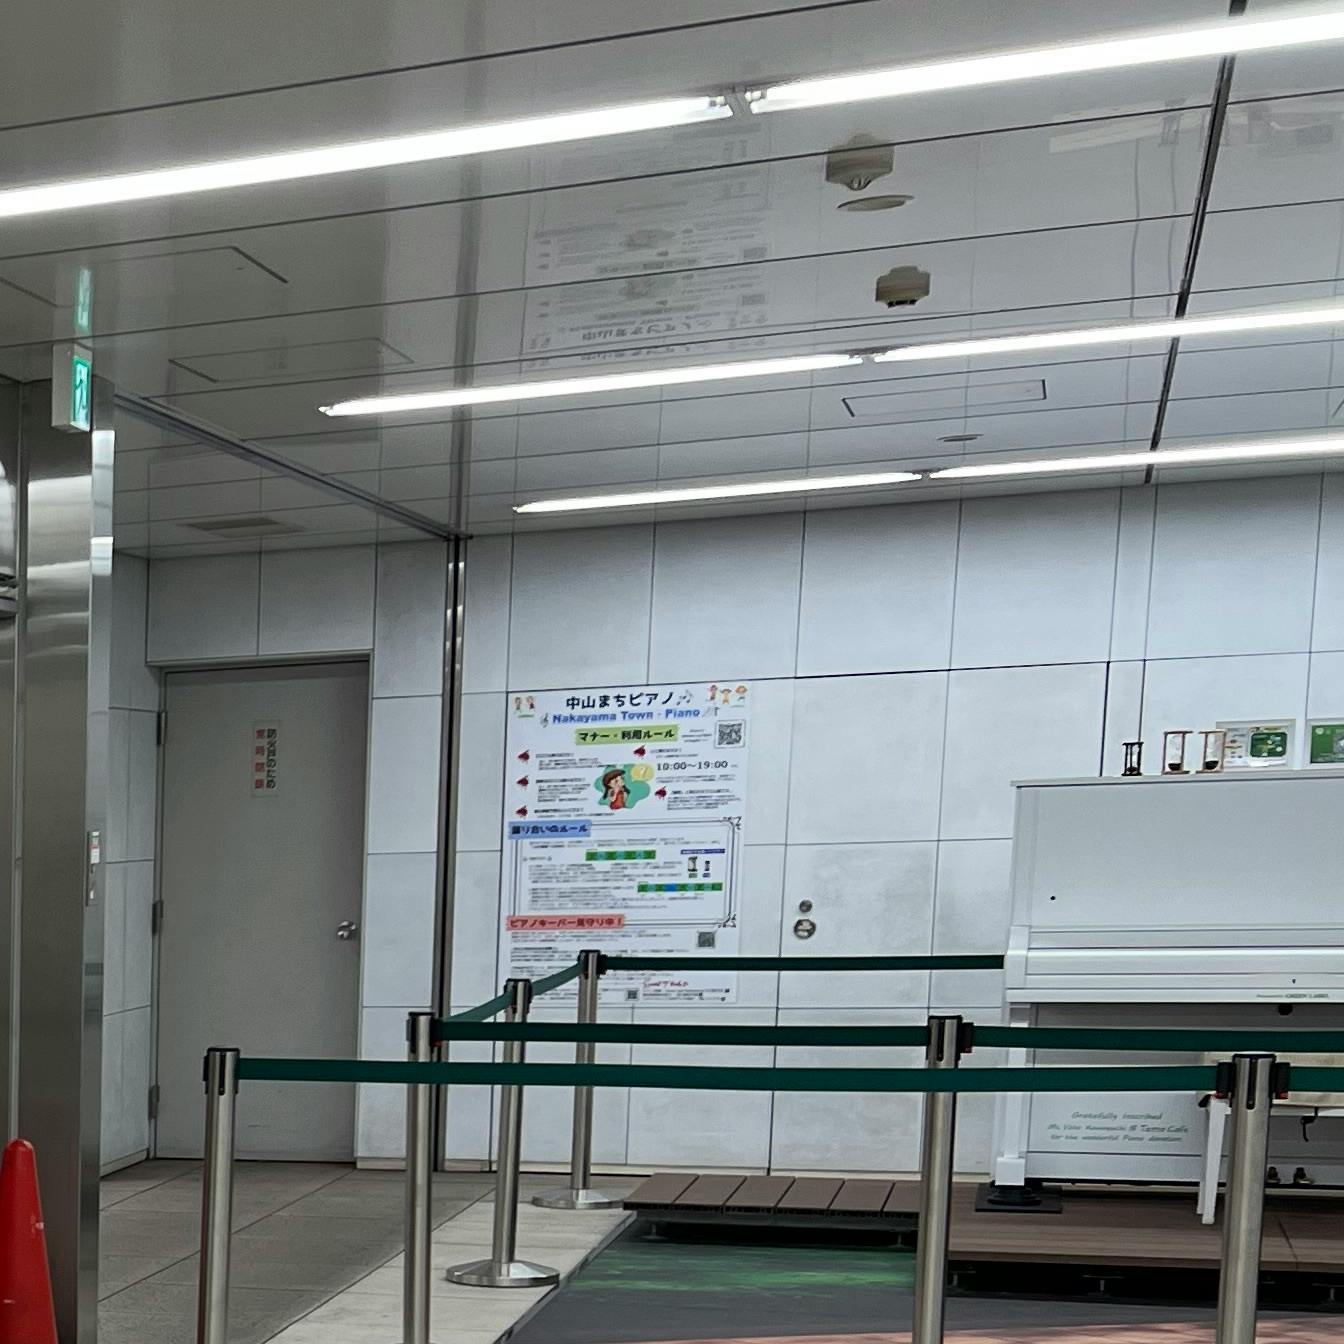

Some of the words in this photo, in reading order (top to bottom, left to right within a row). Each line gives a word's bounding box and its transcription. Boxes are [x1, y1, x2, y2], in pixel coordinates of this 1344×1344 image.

[566, 691, 674, 710] 中山まちピアノ
[552, 712, 617, 725] Nakayama
[621, 711, 653, 721] Town
[665, 708, 700, 719] Piano
